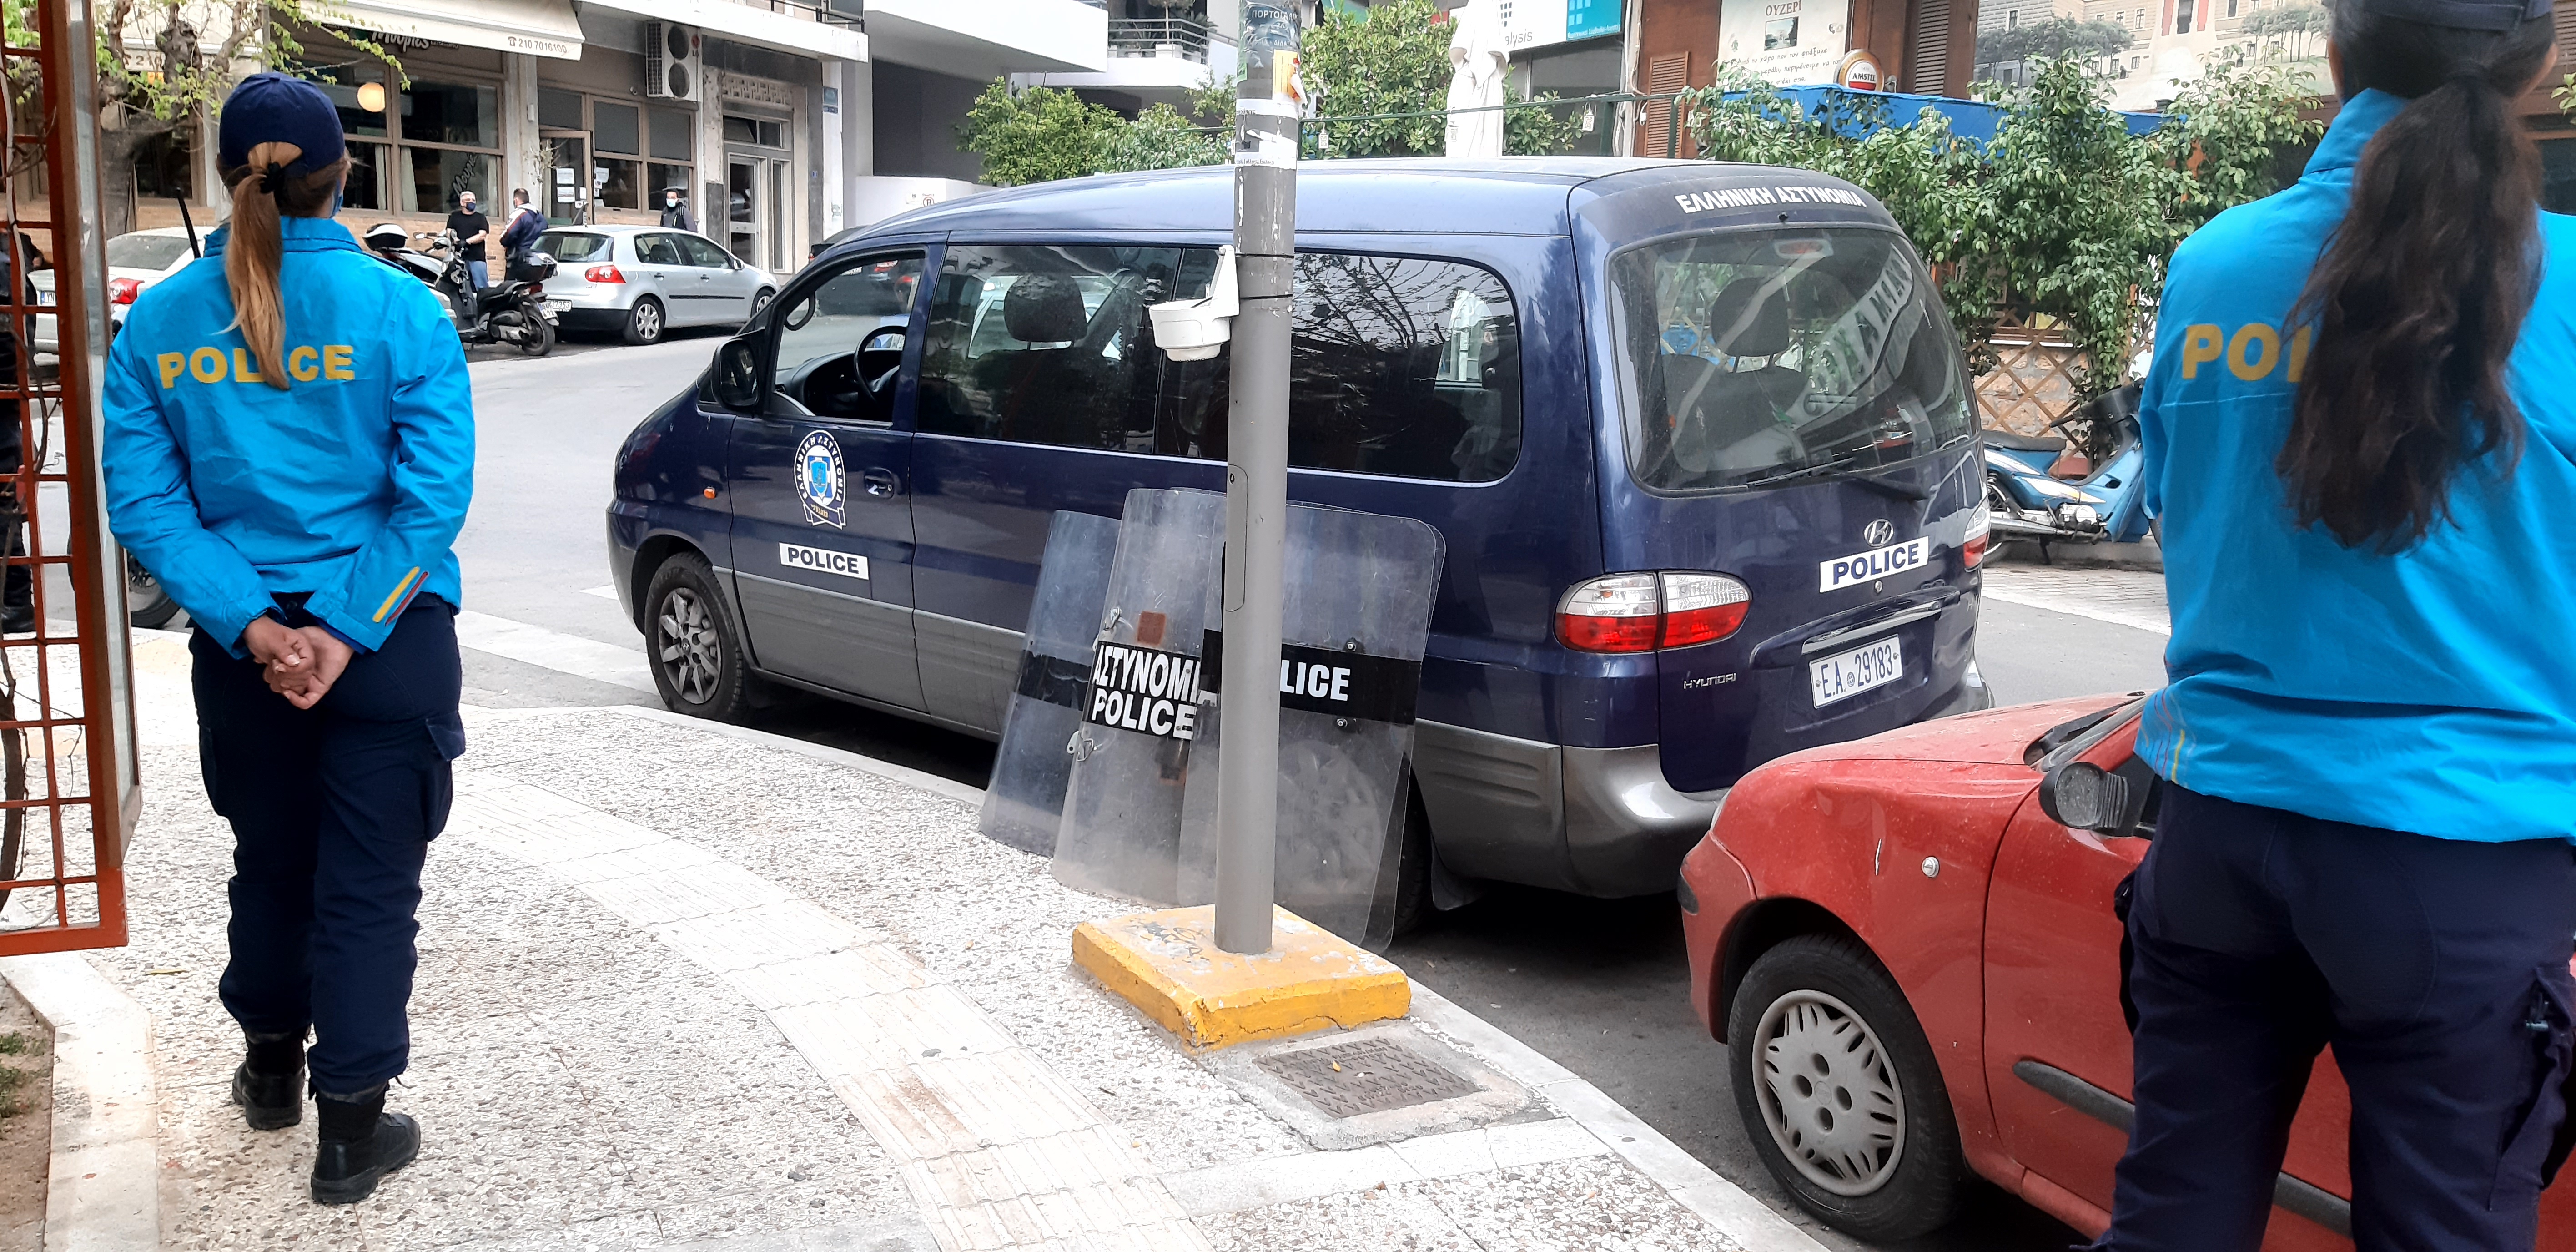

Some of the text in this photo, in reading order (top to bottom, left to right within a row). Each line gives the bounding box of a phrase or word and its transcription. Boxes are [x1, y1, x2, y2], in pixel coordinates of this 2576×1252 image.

[519, 38, 567, 54] 210 7016100
[1675, 187, 1867, 213] ΕΛΛΗΝΙΚΗ ΑΣΤΥΝΟΜΙΑ
[157, 345, 355, 389] POLCE
[788, 547, 859, 574] POLICE
[1833, 543, 1919, 585] POLICE
[1683, 673, 1737, 689] HYUNDAI
[1855, 644, 1893, 687] 29183
[1092, 687, 1197, 747] POLICE
